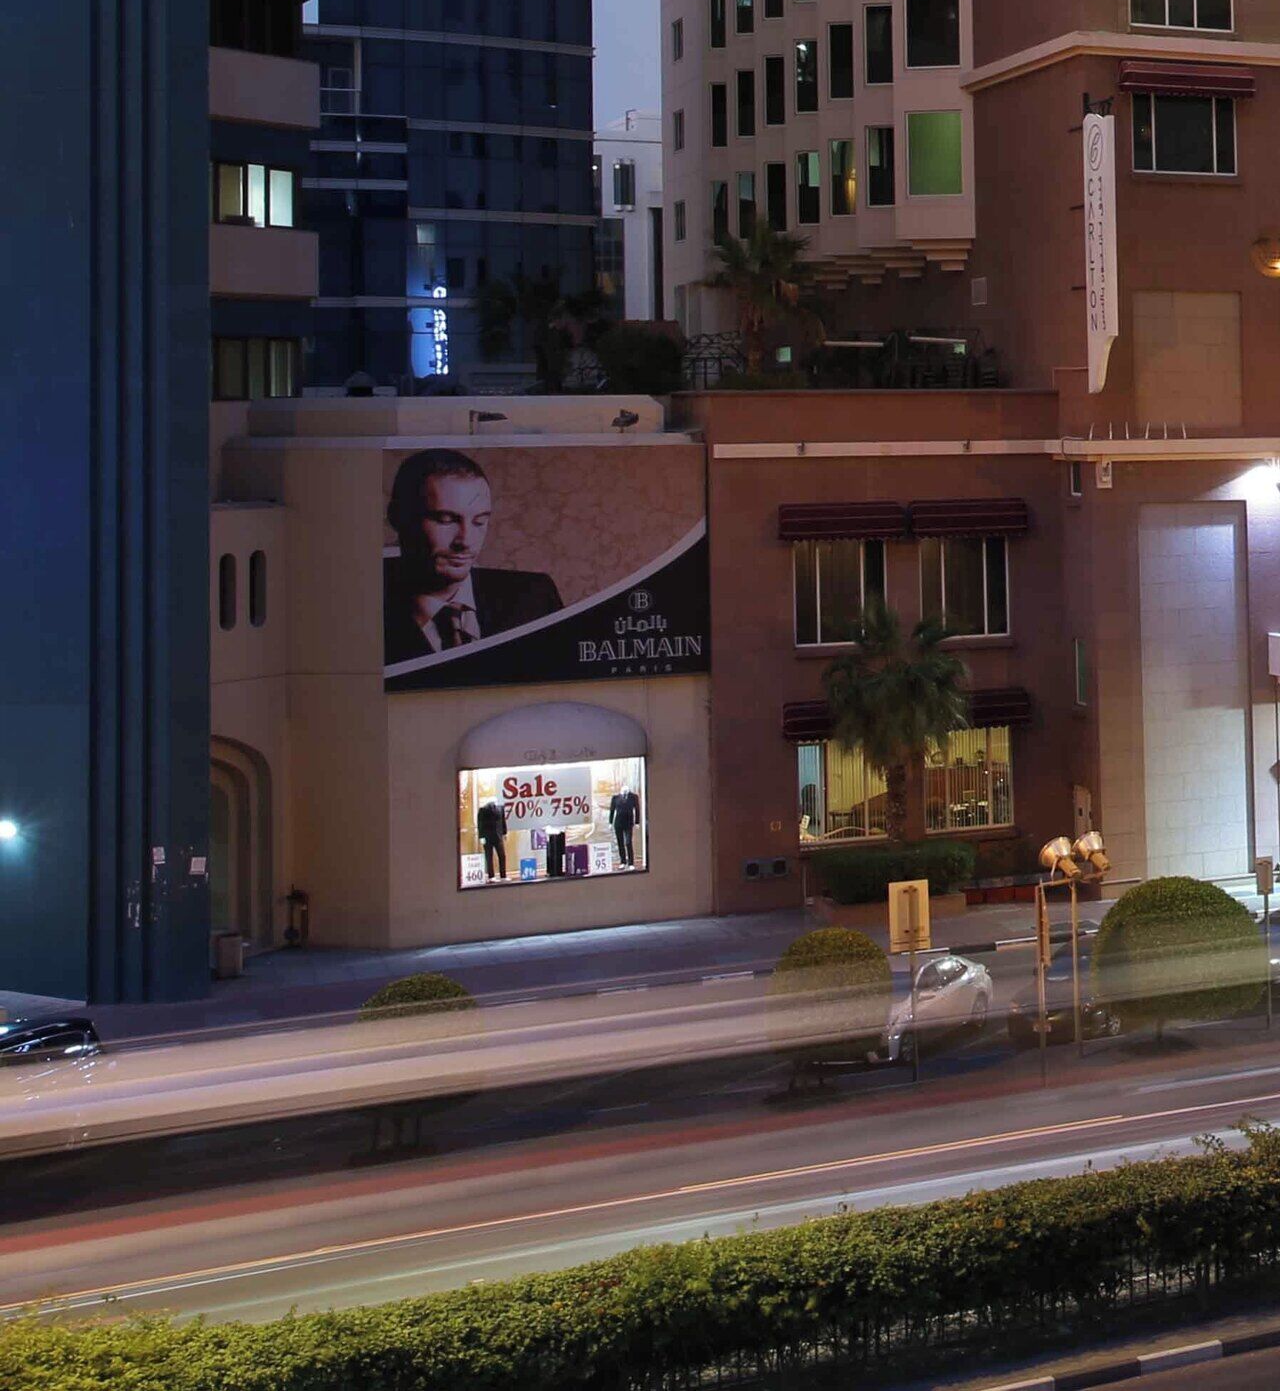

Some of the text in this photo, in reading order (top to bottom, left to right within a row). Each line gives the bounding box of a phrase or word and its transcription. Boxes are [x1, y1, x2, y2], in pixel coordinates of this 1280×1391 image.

[1087, 178, 1098, 332] CARLTON
[614, 614, 668, 635] بالمان
[578, 636, 703, 662] BALMAIN
[610, 663, 673, 674] PARIS
[502, 774, 558, 800] Sale
[503, 795, 590, 821] 70% 75%
[465, 869, 483, 882] 460
[595, 858, 607, 870] 95
